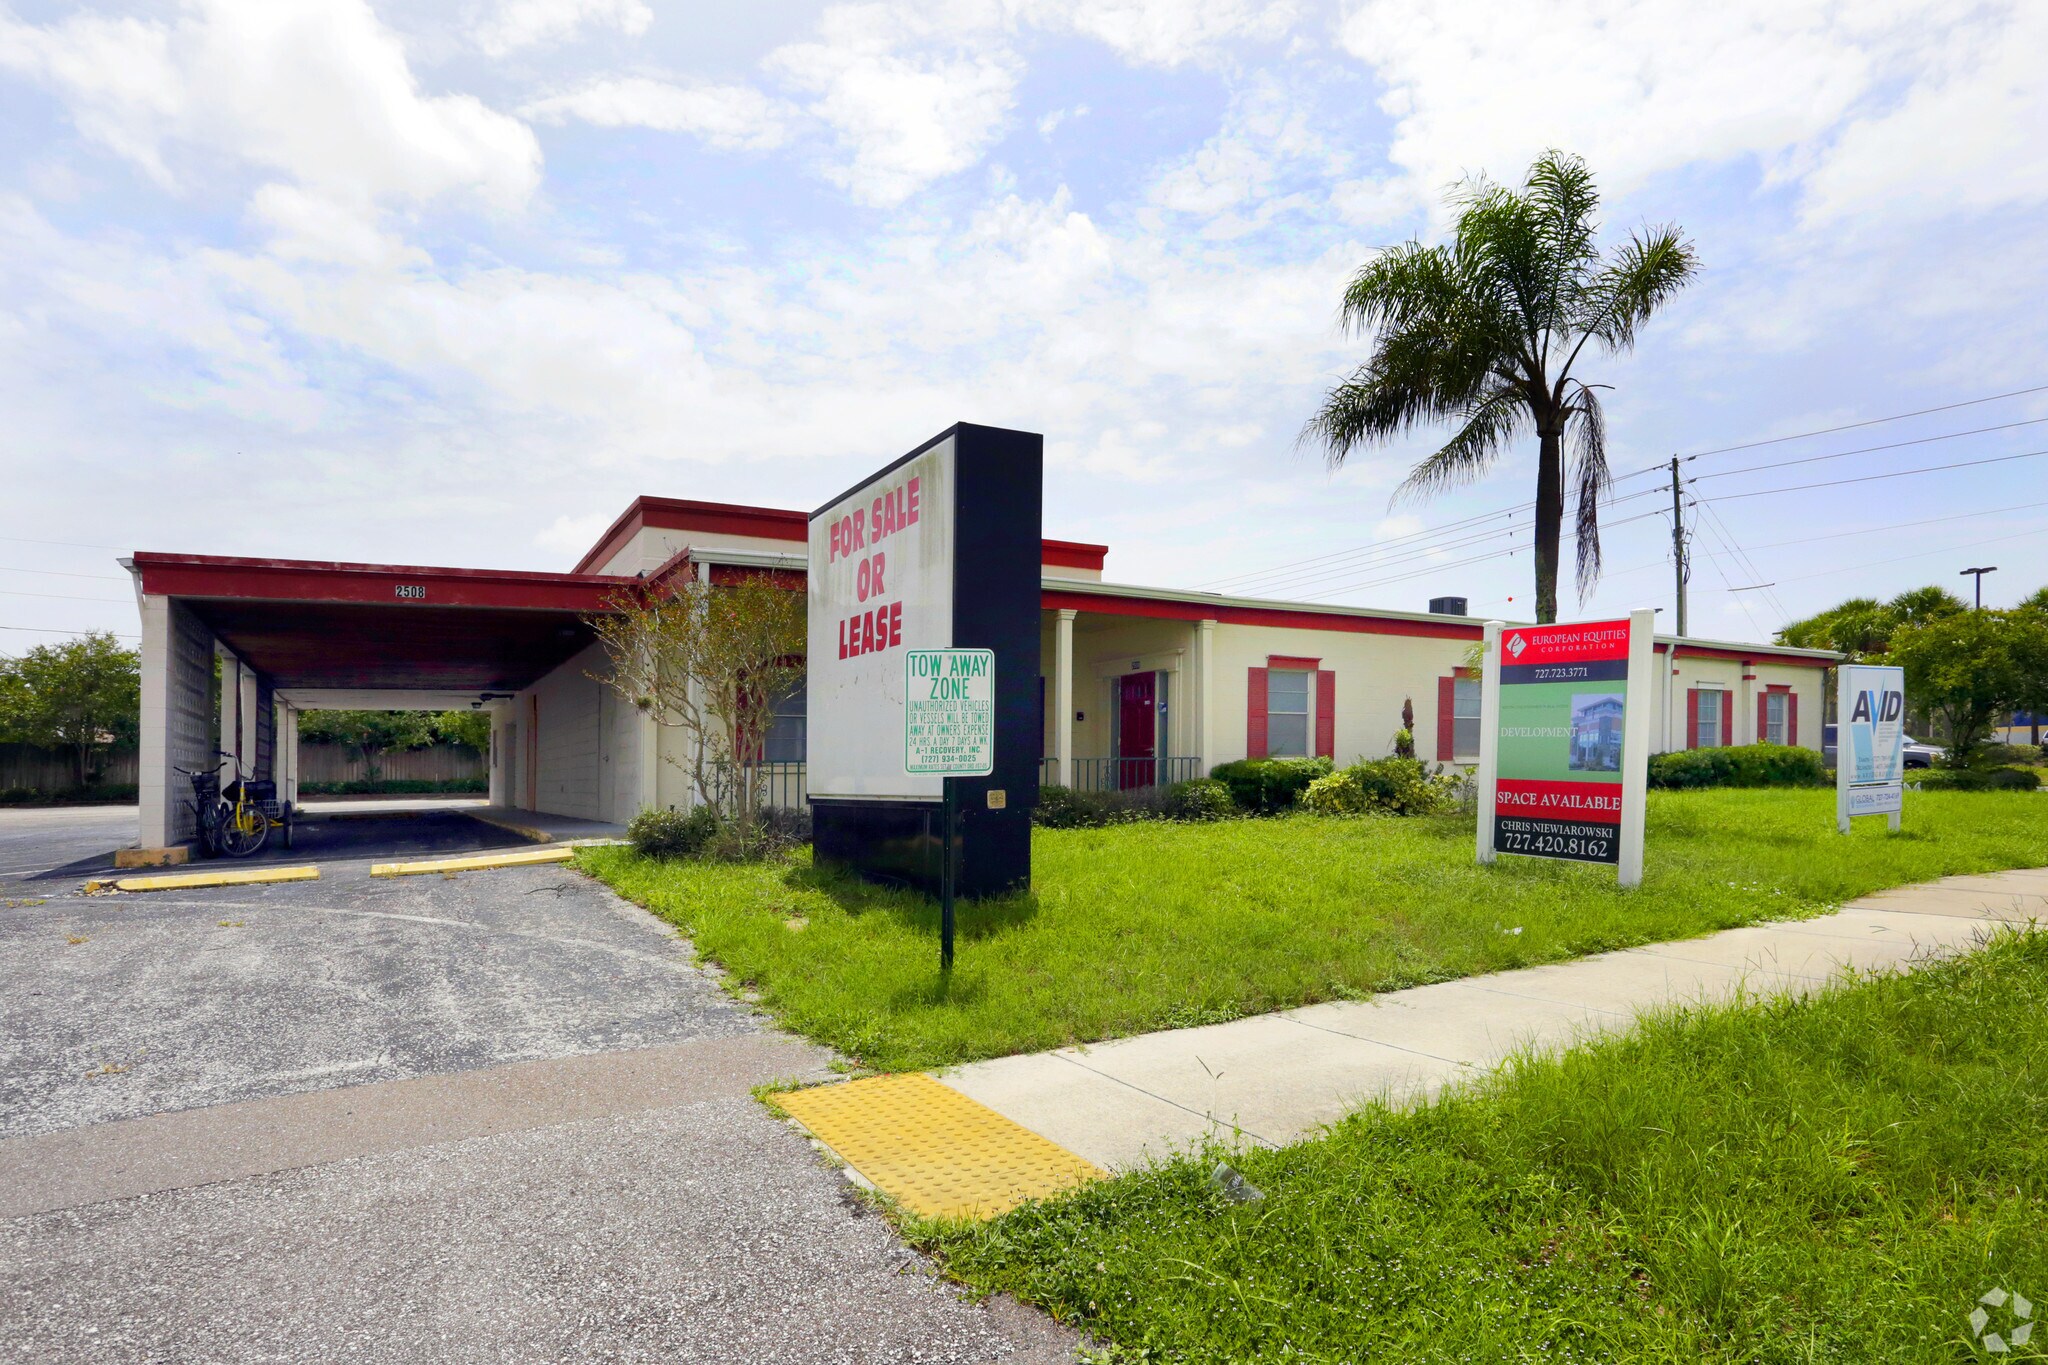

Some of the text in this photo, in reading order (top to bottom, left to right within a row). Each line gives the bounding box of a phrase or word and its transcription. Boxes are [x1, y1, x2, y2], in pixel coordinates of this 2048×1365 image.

[830, 476, 919, 563] FOR SALE
[857, 552, 885, 602] OR
[396, 585, 424, 598] 2508
[839, 601, 902, 660] LEASE
[1532, 629, 1627, 645] EUROPEAN EQUITIES
[1541, 643, 1615, 653] CORPORATION
[910, 654, 989, 677] TOW AWAY
[1535, 667, 1588, 679] 727.723.3771
[930, 677, 970, 700] ZONE
[909, 701, 989, 712] UNAUTHORIZED VEHICLES
[1851, 680, 1902, 734] AVID
[909, 712, 989, 724] OR VESSELS WILL BE TOWED
[909, 724, 989, 736] AWAY AT OWNERS EXPENSE
[1501, 727, 1578, 738] DEVELOPMENT
[909, 737, 917, 746] 24
[933, 737, 938, 746] A
[940, 737, 949, 746] DAY
[952, 737, 956, 745] 7
[957, 736, 971, 746] DAYS
[973, 736, 977, 745] A
[915, 747, 928, 755] A-1
[921, 754, 977, 763] (727) 934-0025
[1497, 791, 1621, 810] SPACE AVAILABLE
[1501, 820, 1613, 839] CHRIS NIEWIAROWSKI
[1505, 833, 1608, 857] 727.420.8162
